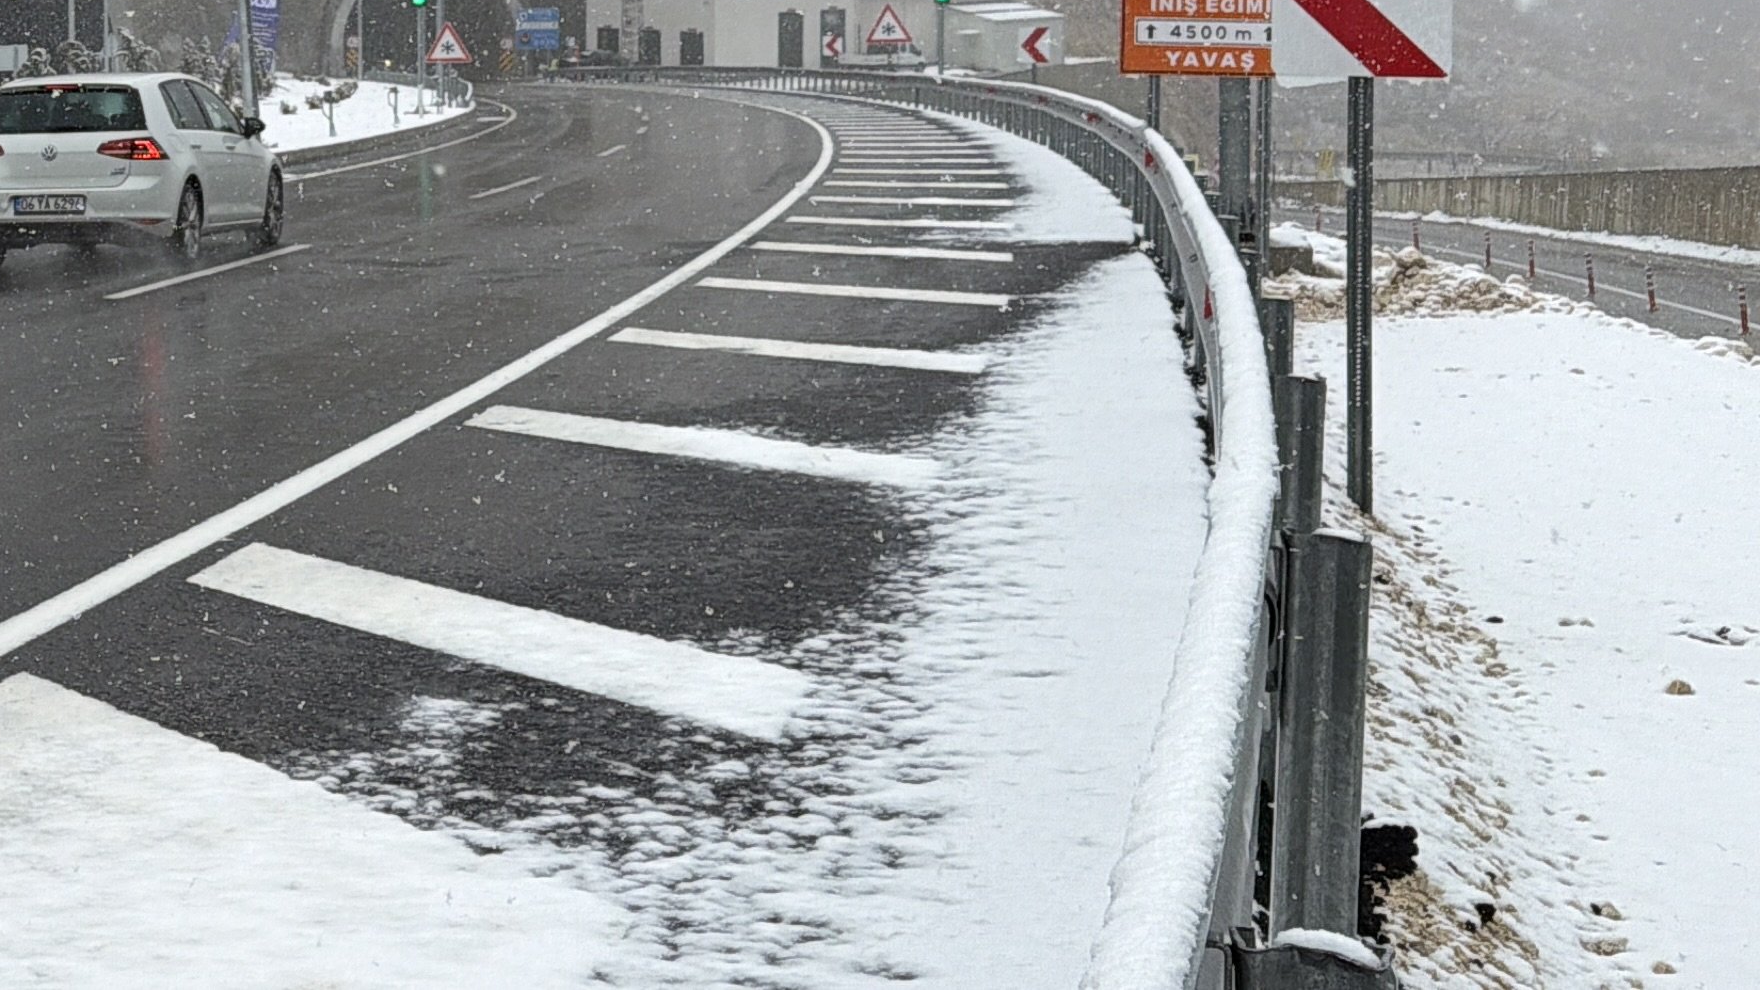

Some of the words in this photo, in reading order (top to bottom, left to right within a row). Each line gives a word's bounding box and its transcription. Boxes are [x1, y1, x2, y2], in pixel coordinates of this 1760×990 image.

[1170, 25, 1227, 41] 4500
[1235, 29, 1252, 41] m
[1165, 49, 1256, 72] YAVAŞ
